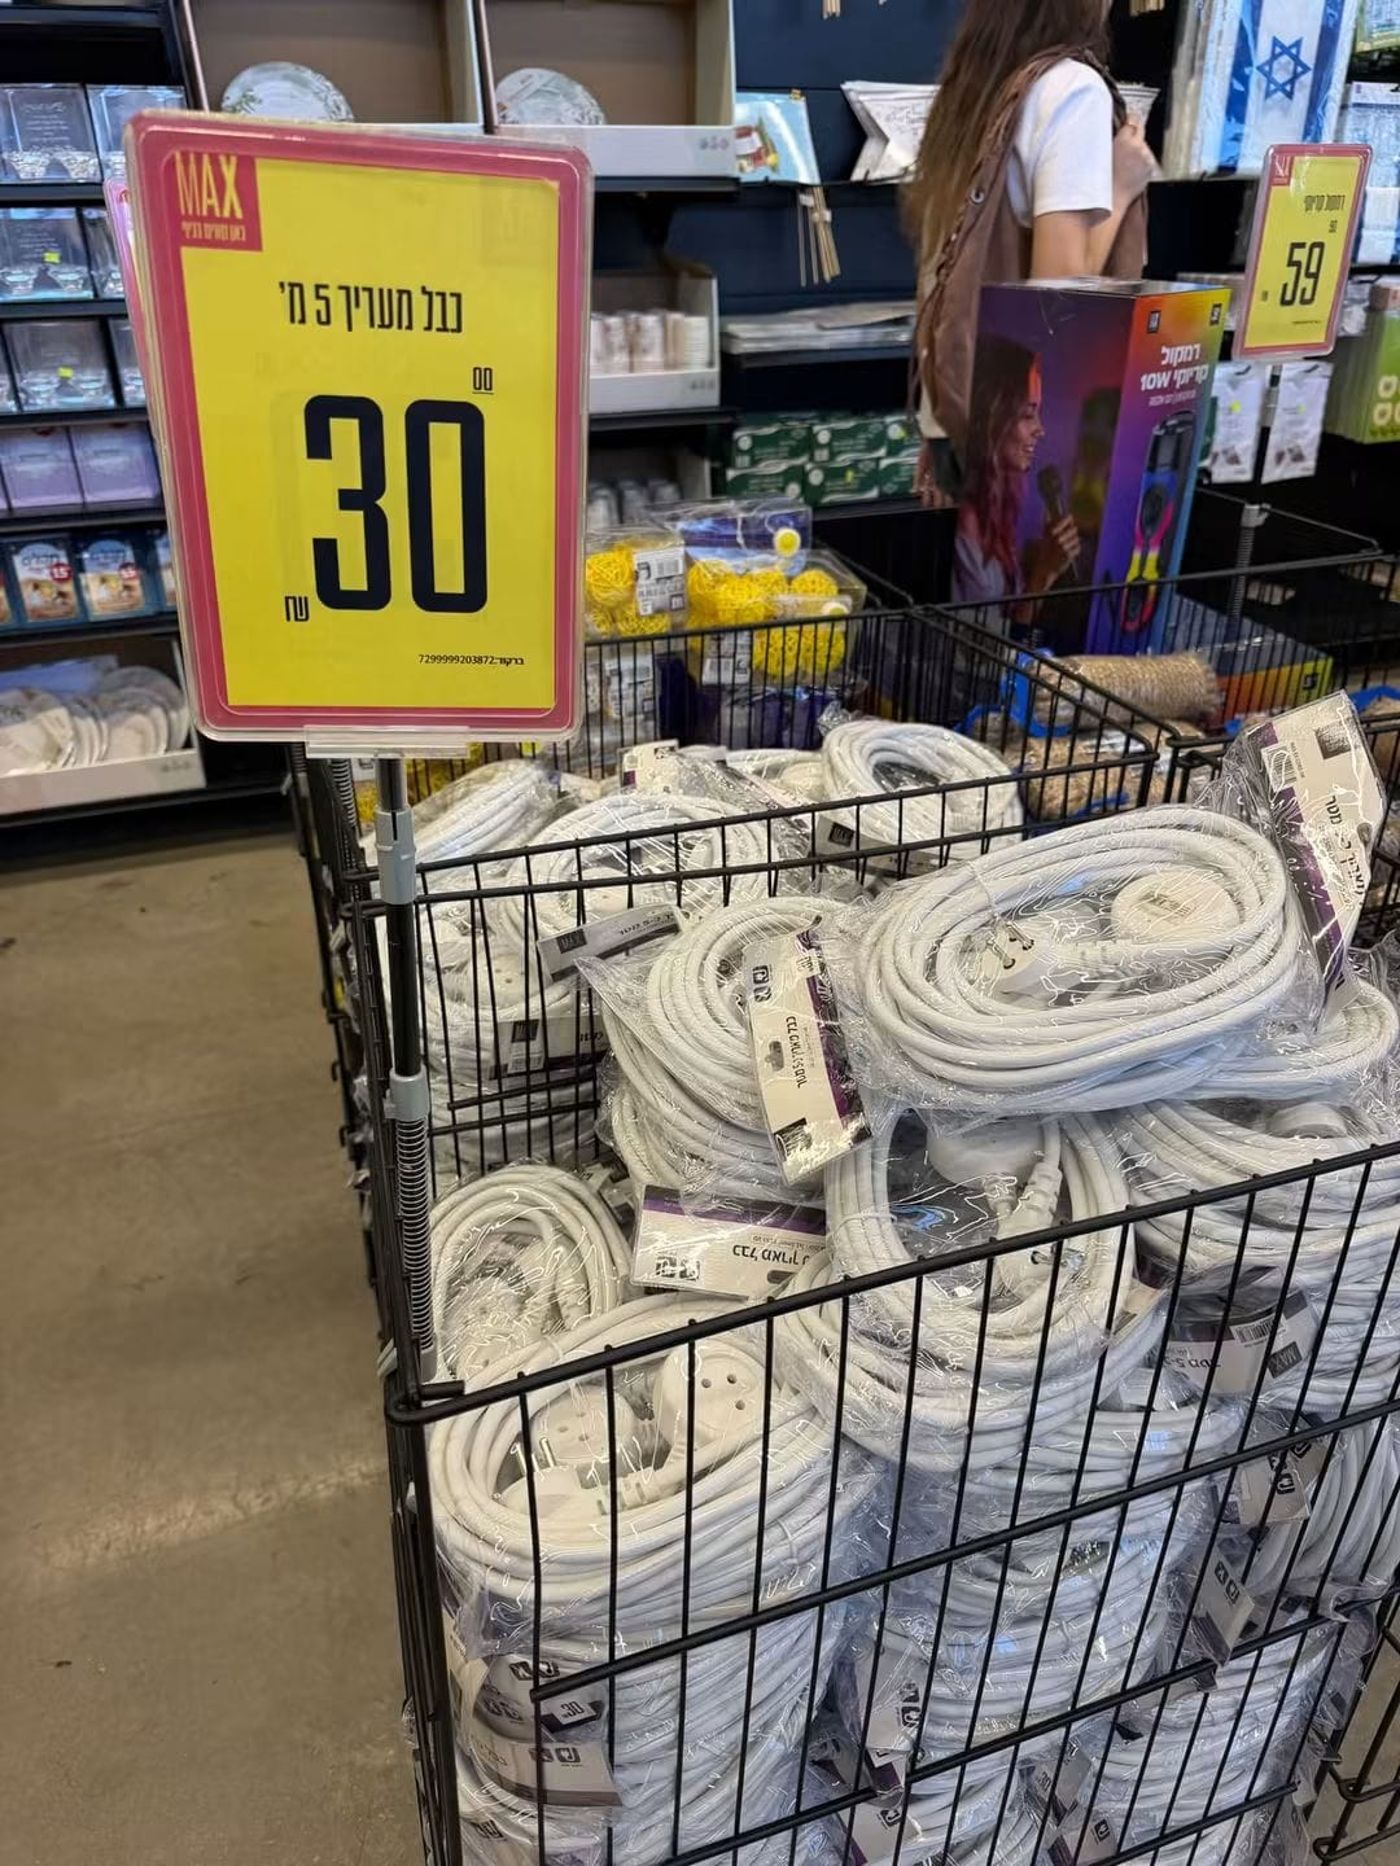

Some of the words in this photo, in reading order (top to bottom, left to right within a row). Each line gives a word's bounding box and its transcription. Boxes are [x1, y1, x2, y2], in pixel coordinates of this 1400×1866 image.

[175, 150, 243, 219] MAX
[1280, 241, 1325, 306] 59
[279, 281, 306, 324] מ'
[314, 283, 331, 326] 5
[337, 285, 413, 332] מעריך
[421, 285, 462, 333] כבל
[1161, 343, 1201, 367] רמקול
[472, 366, 494, 391] 00
[1140, 370, 1172, 391] 10W
[1173, 364, 1209, 389] קריוקי
[304, 394, 488, 613] 30
[784, 1015, 798, 1033] כבל
[732, 1244, 758, 1261] כבל
[761, 1247, 799, 1266] מאריך
[560, 1700, 585, 1718] 30
